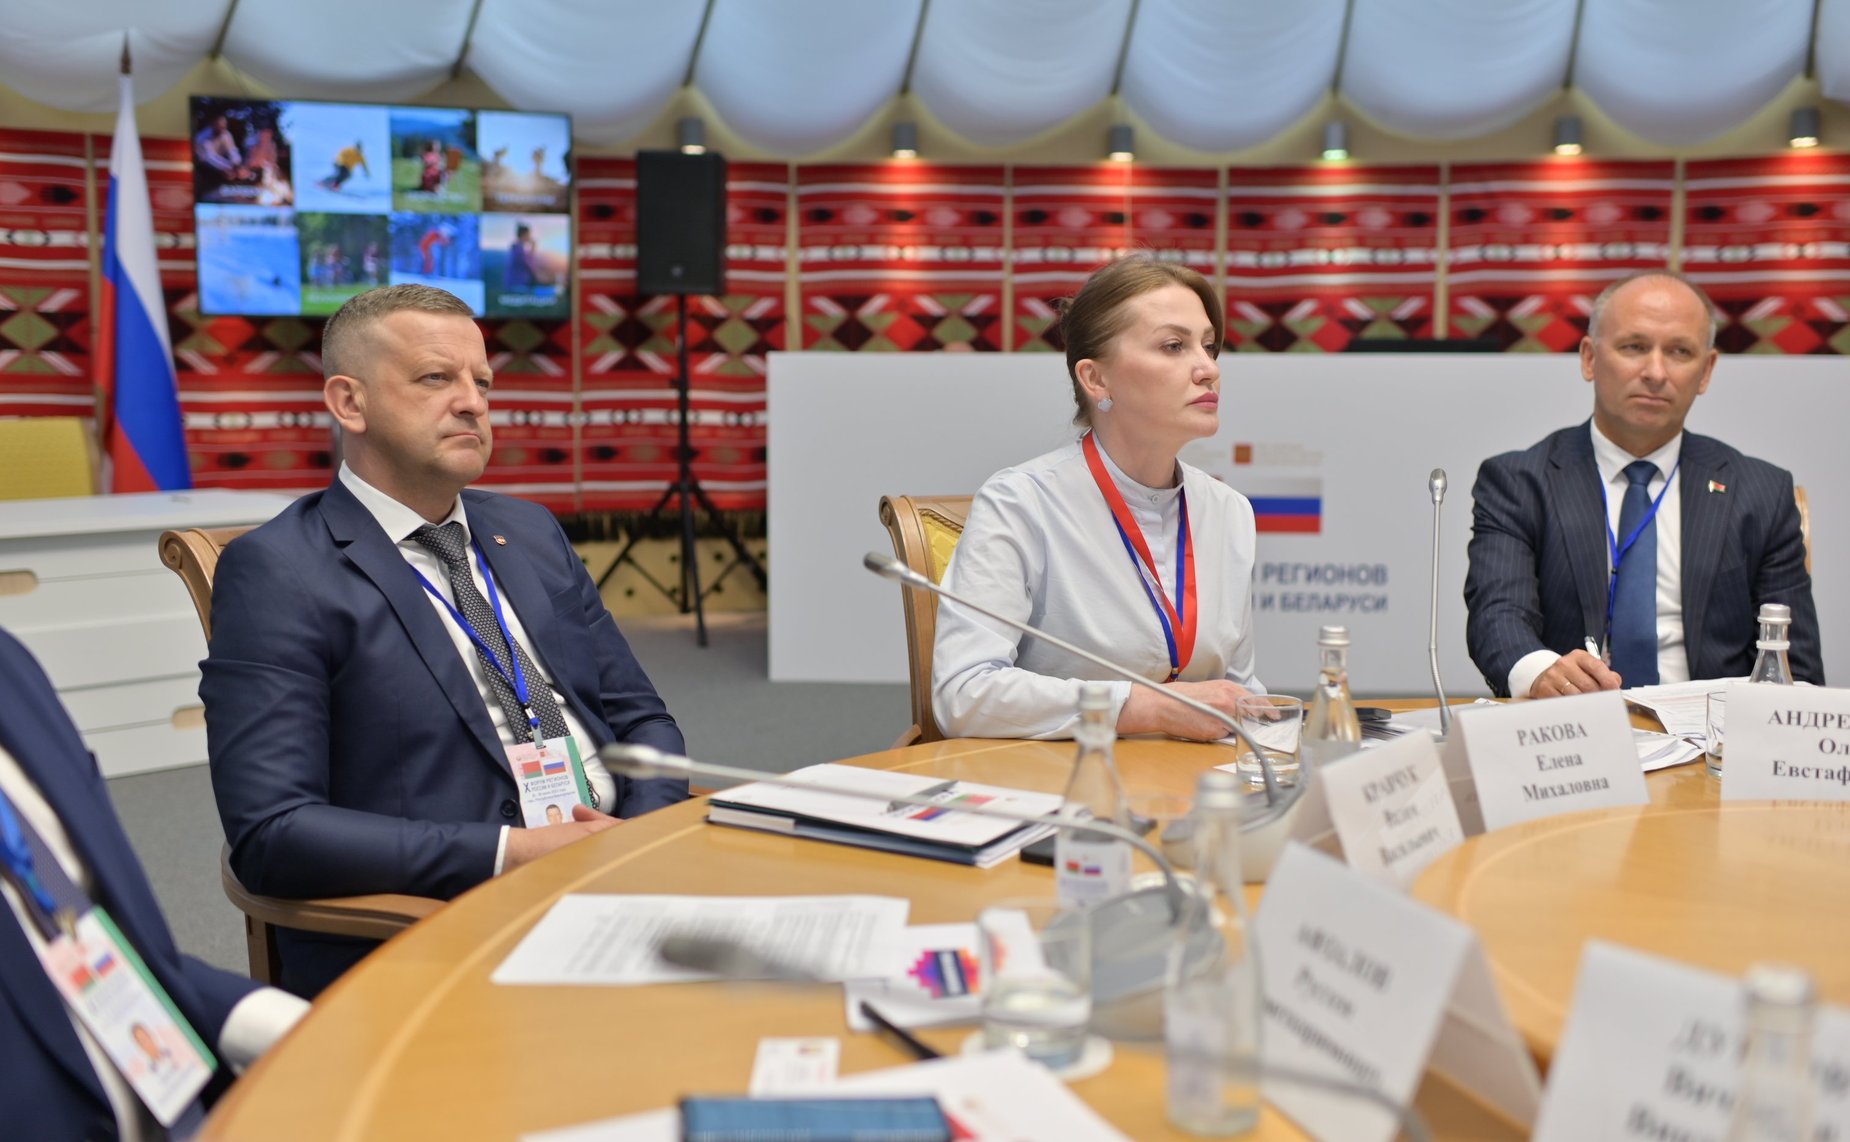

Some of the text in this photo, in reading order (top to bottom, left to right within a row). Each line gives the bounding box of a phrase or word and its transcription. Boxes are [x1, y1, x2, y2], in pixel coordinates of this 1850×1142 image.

[1262, 563, 1388, 585] РЕГИОНОВ
[1261, 593, 1388, 612] И БЕЛАРУСИ
[1516, 722, 1588, 746] РАКОВА
[1536, 753, 1584, 772] Елена
[1522, 777, 1610, 802] Михаловна
